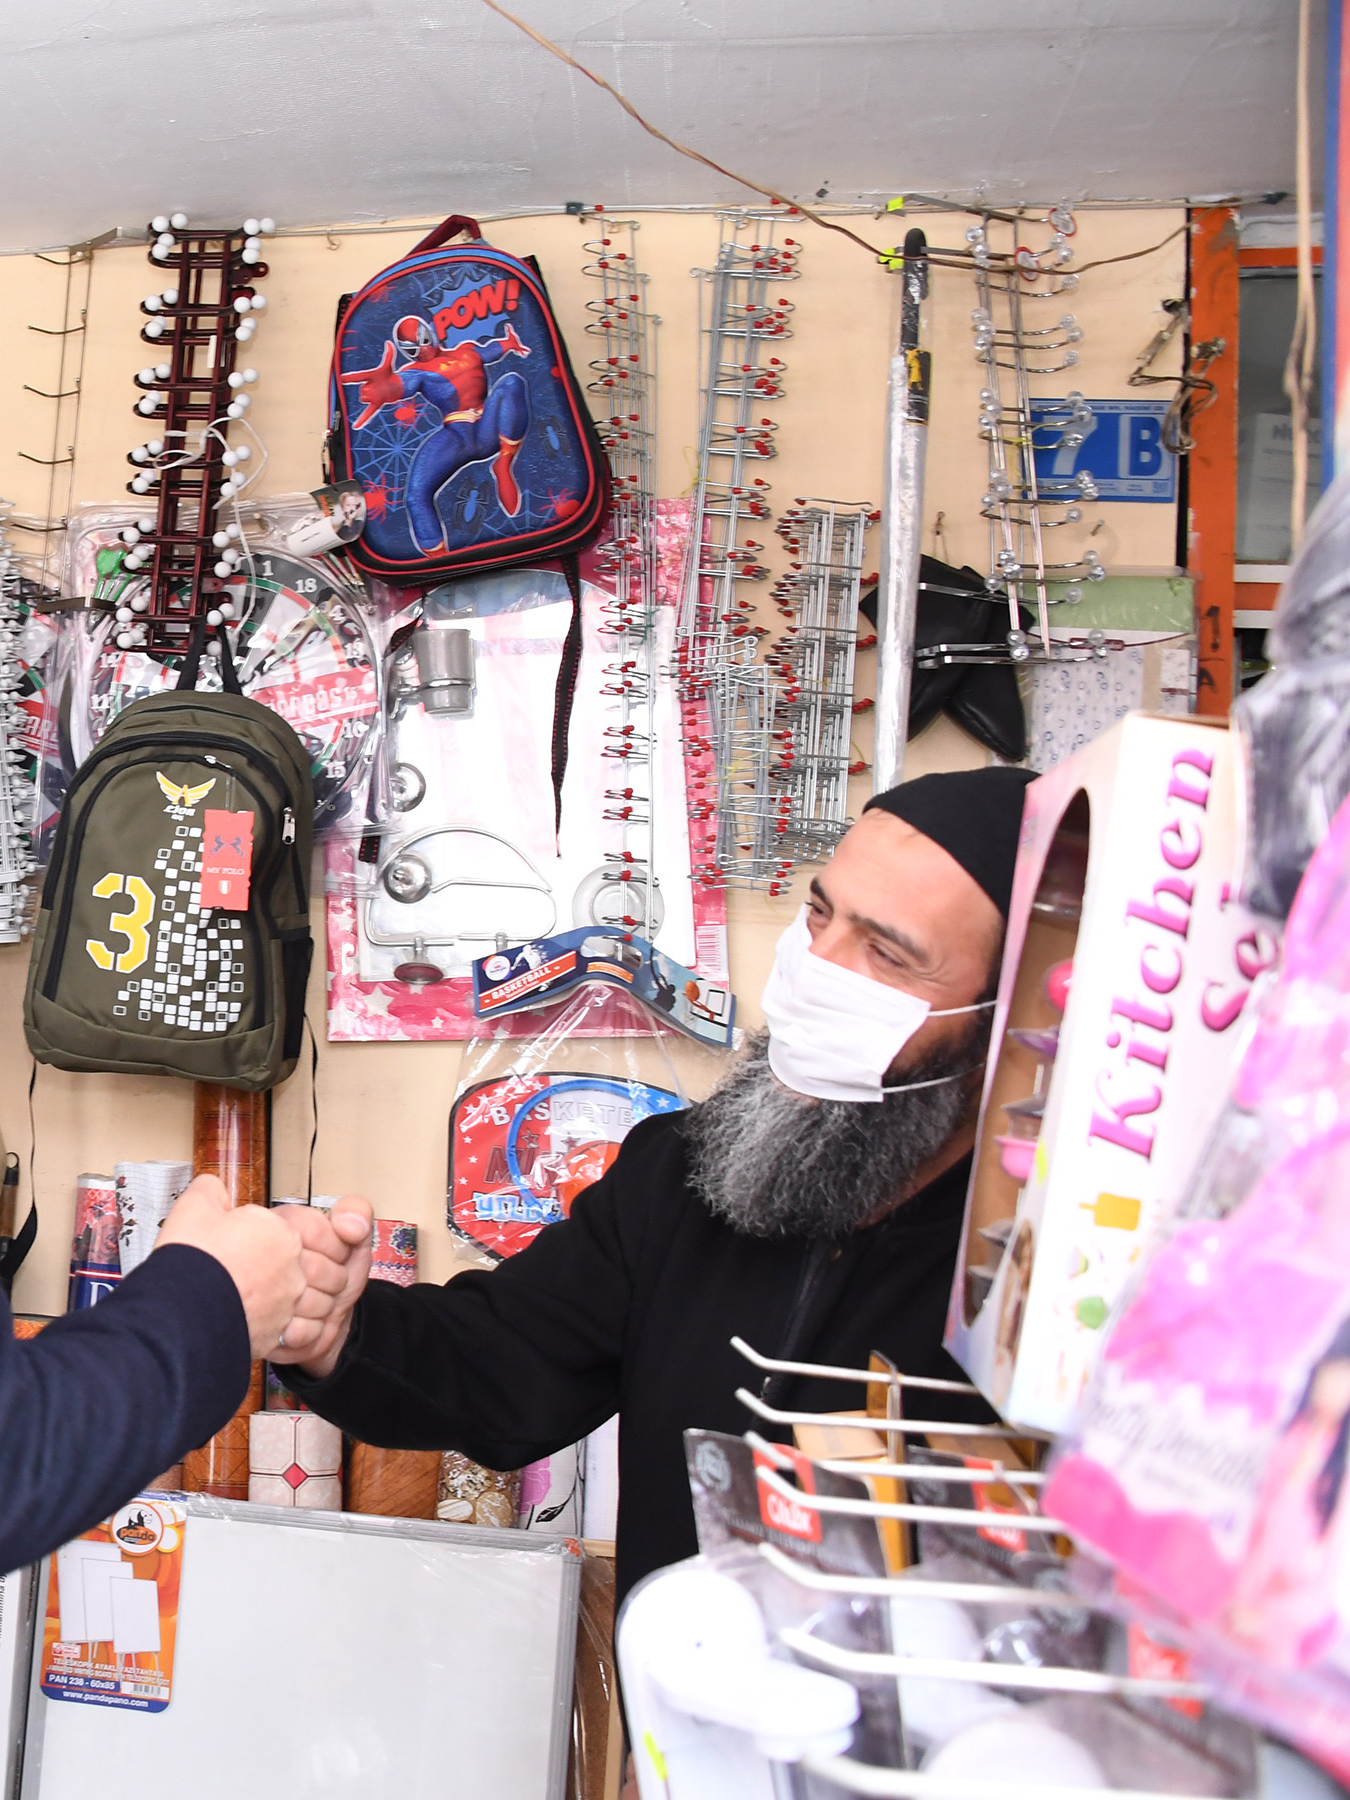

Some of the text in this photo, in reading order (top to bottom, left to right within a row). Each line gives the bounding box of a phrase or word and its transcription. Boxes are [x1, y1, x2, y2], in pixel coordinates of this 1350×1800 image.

[432, 279, 521, 341] POW!
[1043, 415, 1163, 476] 7 B
[294, 577, 318, 593] 18
[325, 763, 347, 778] 15
[221, 867, 246, 876] POLO
[86, 873, 156, 974] 3
[1088, 748, 1215, 1163] Kitchen
[1200, 880, 1278, 1033] Se
[491, 966, 552, 1000] BASKETBALL
[119, 1528, 156, 1542] panda
[48, 1675, 68, 1684] PAN
